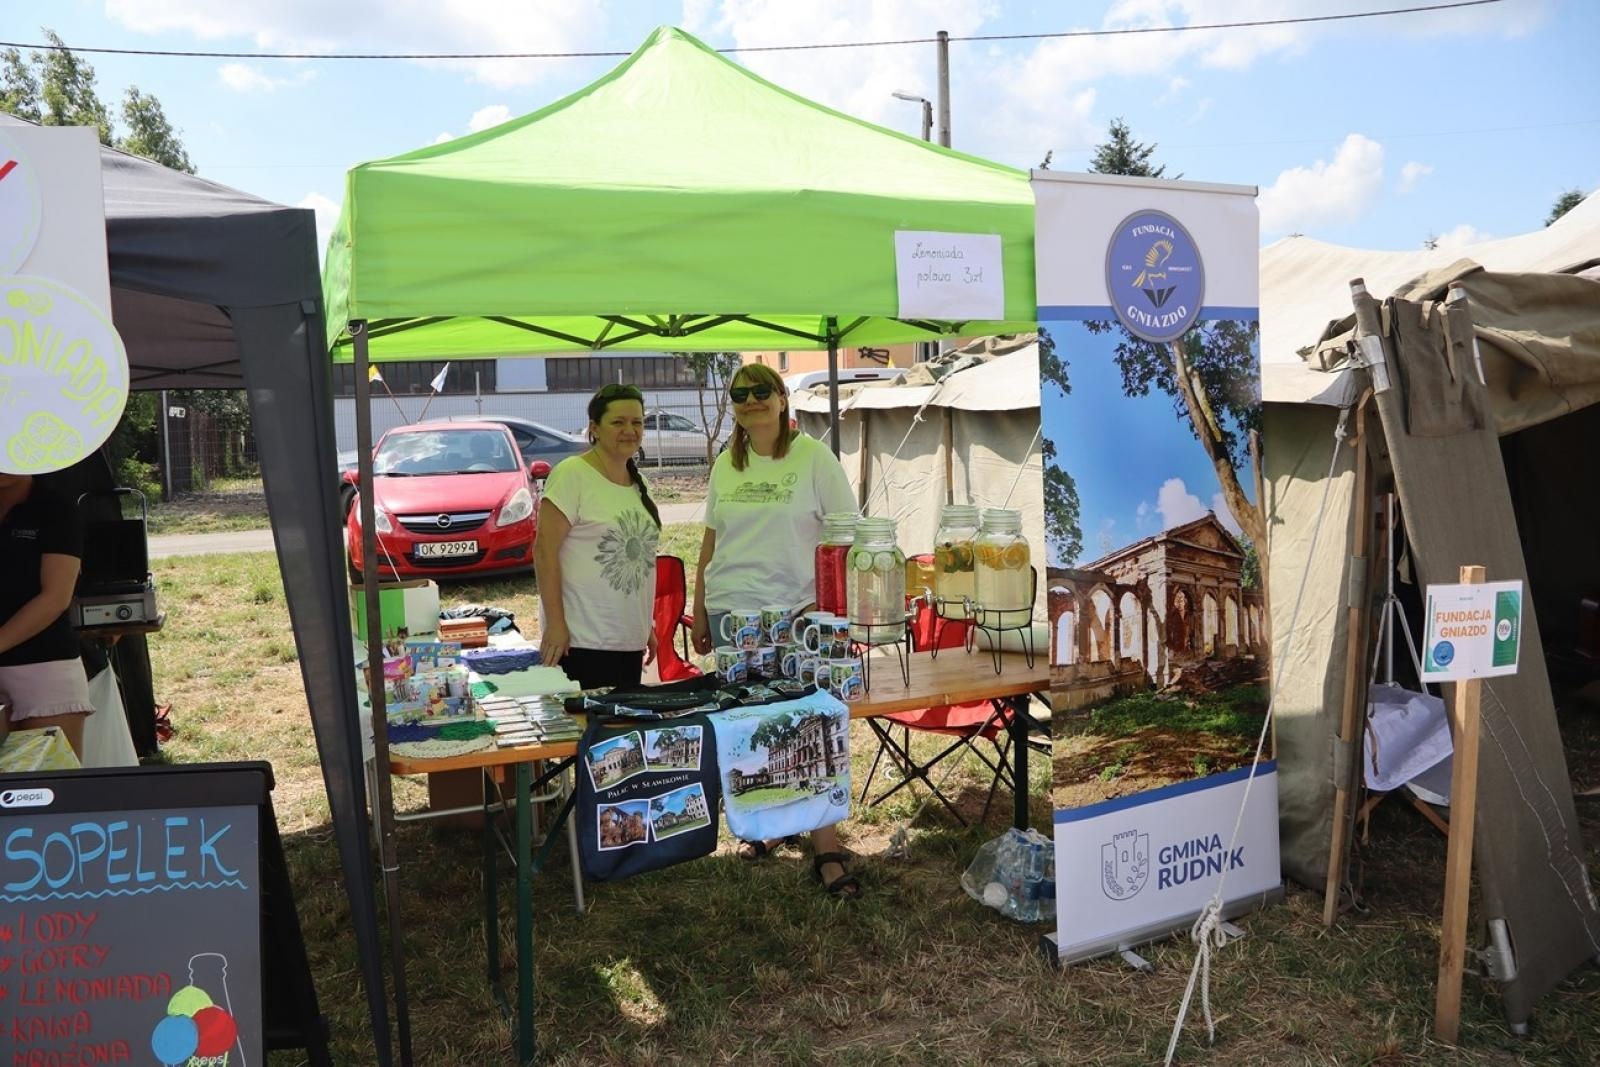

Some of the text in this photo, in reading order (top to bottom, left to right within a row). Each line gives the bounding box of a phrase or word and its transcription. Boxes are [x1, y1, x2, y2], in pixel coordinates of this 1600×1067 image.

[1132, 224, 1175, 239] FUNDACJA
[911, 241, 964, 259] Lemoniada
[1127, 305, 1187, 328] GNIAZDO
[421, 541, 475, 555] OK 92994
[1436, 609, 1492, 622] FUNDACJA
[1440, 625, 1487, 638] GNIAZDO
[16, 792, 43, 802] pepsi
[4, 816, 240, 892] SOPELEK
[1158, 833, 1222, 865] GMINA
[18, 910, 98, 945] LODY
[19, 943, 112, 977] GOFRY
[19, 971, 172, 1006] LEMONIADA
[11, 1009, 92, 1044] KAWA
